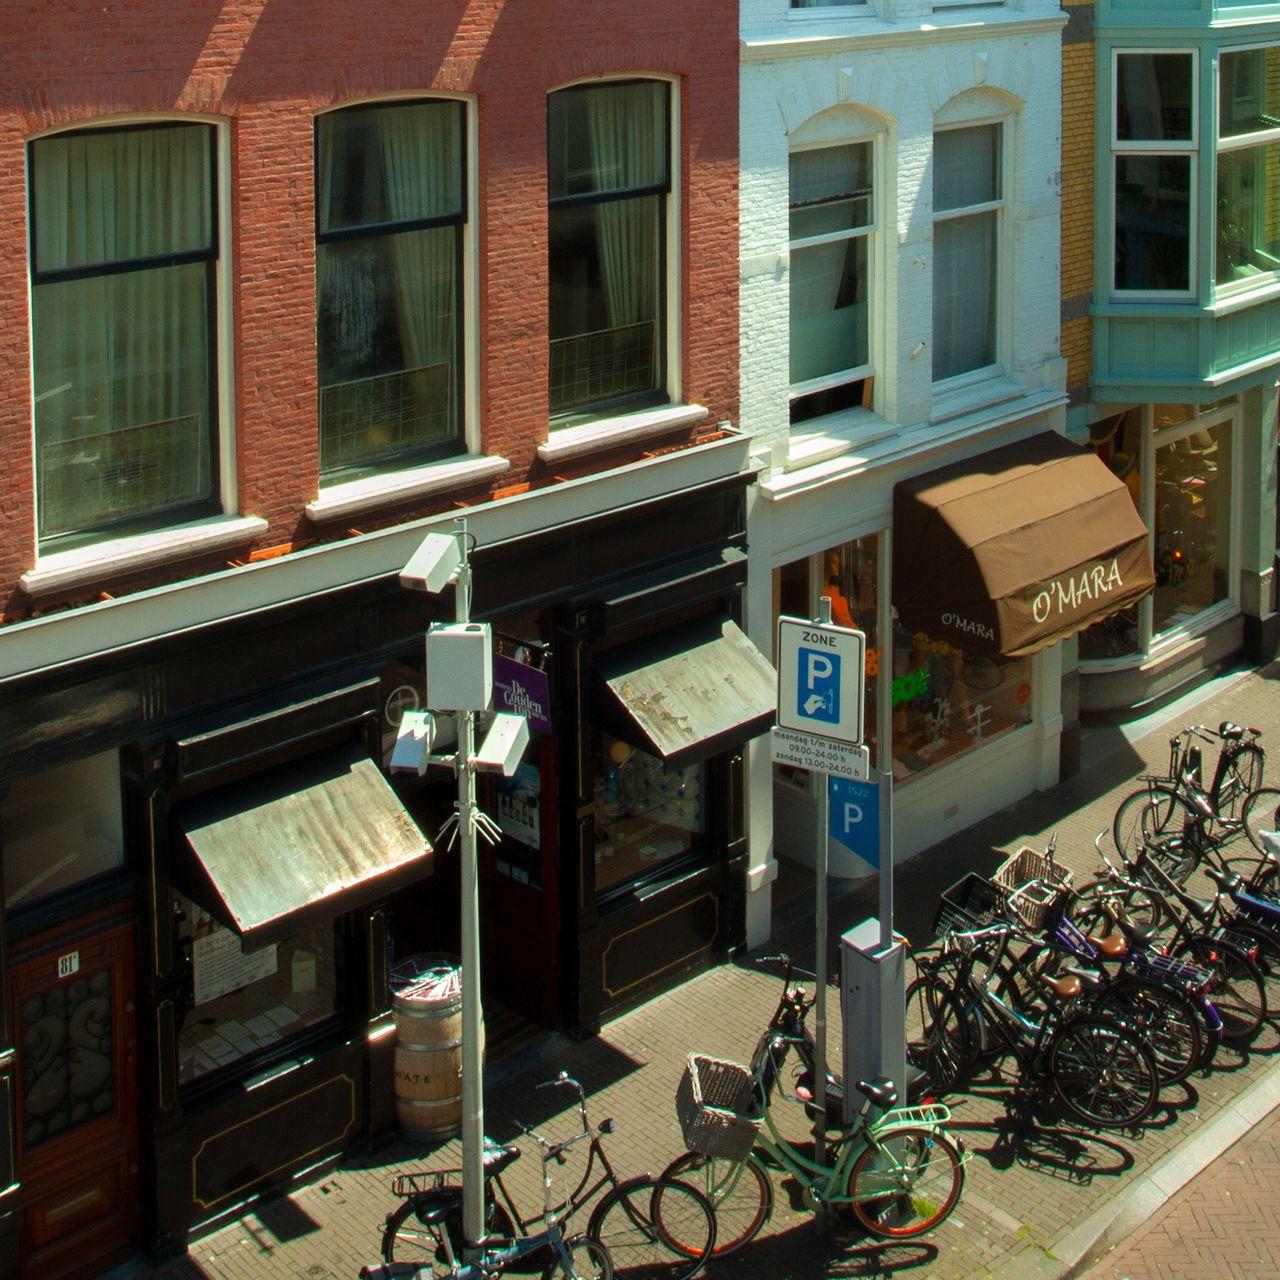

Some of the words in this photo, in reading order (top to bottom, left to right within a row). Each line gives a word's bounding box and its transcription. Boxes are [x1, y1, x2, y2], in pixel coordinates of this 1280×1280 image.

[1033, 559, 1123, 623] O'MARA
[802, 631, 837, 648] ZONE
[941, 613, 994, 641] O'MARA
[807, 653, 833, 690] P
[504, 690, 541, 714] Gouden
[512, 680, 526, 697] De
[774, 731, 808, 746] maandag
[811, 738, 825, 750] t/m
[828, 743, 863, 759] zaterdag
[789, 744, 838, 762] 09.00-24.00
[840, 756, 846, 764] h
[776, 752, 802, 765] zondag
[805, 757, 852, 776] 13.00-24.00
[854, 769, 860, 778] h
[844, 802, 864, 833] P
